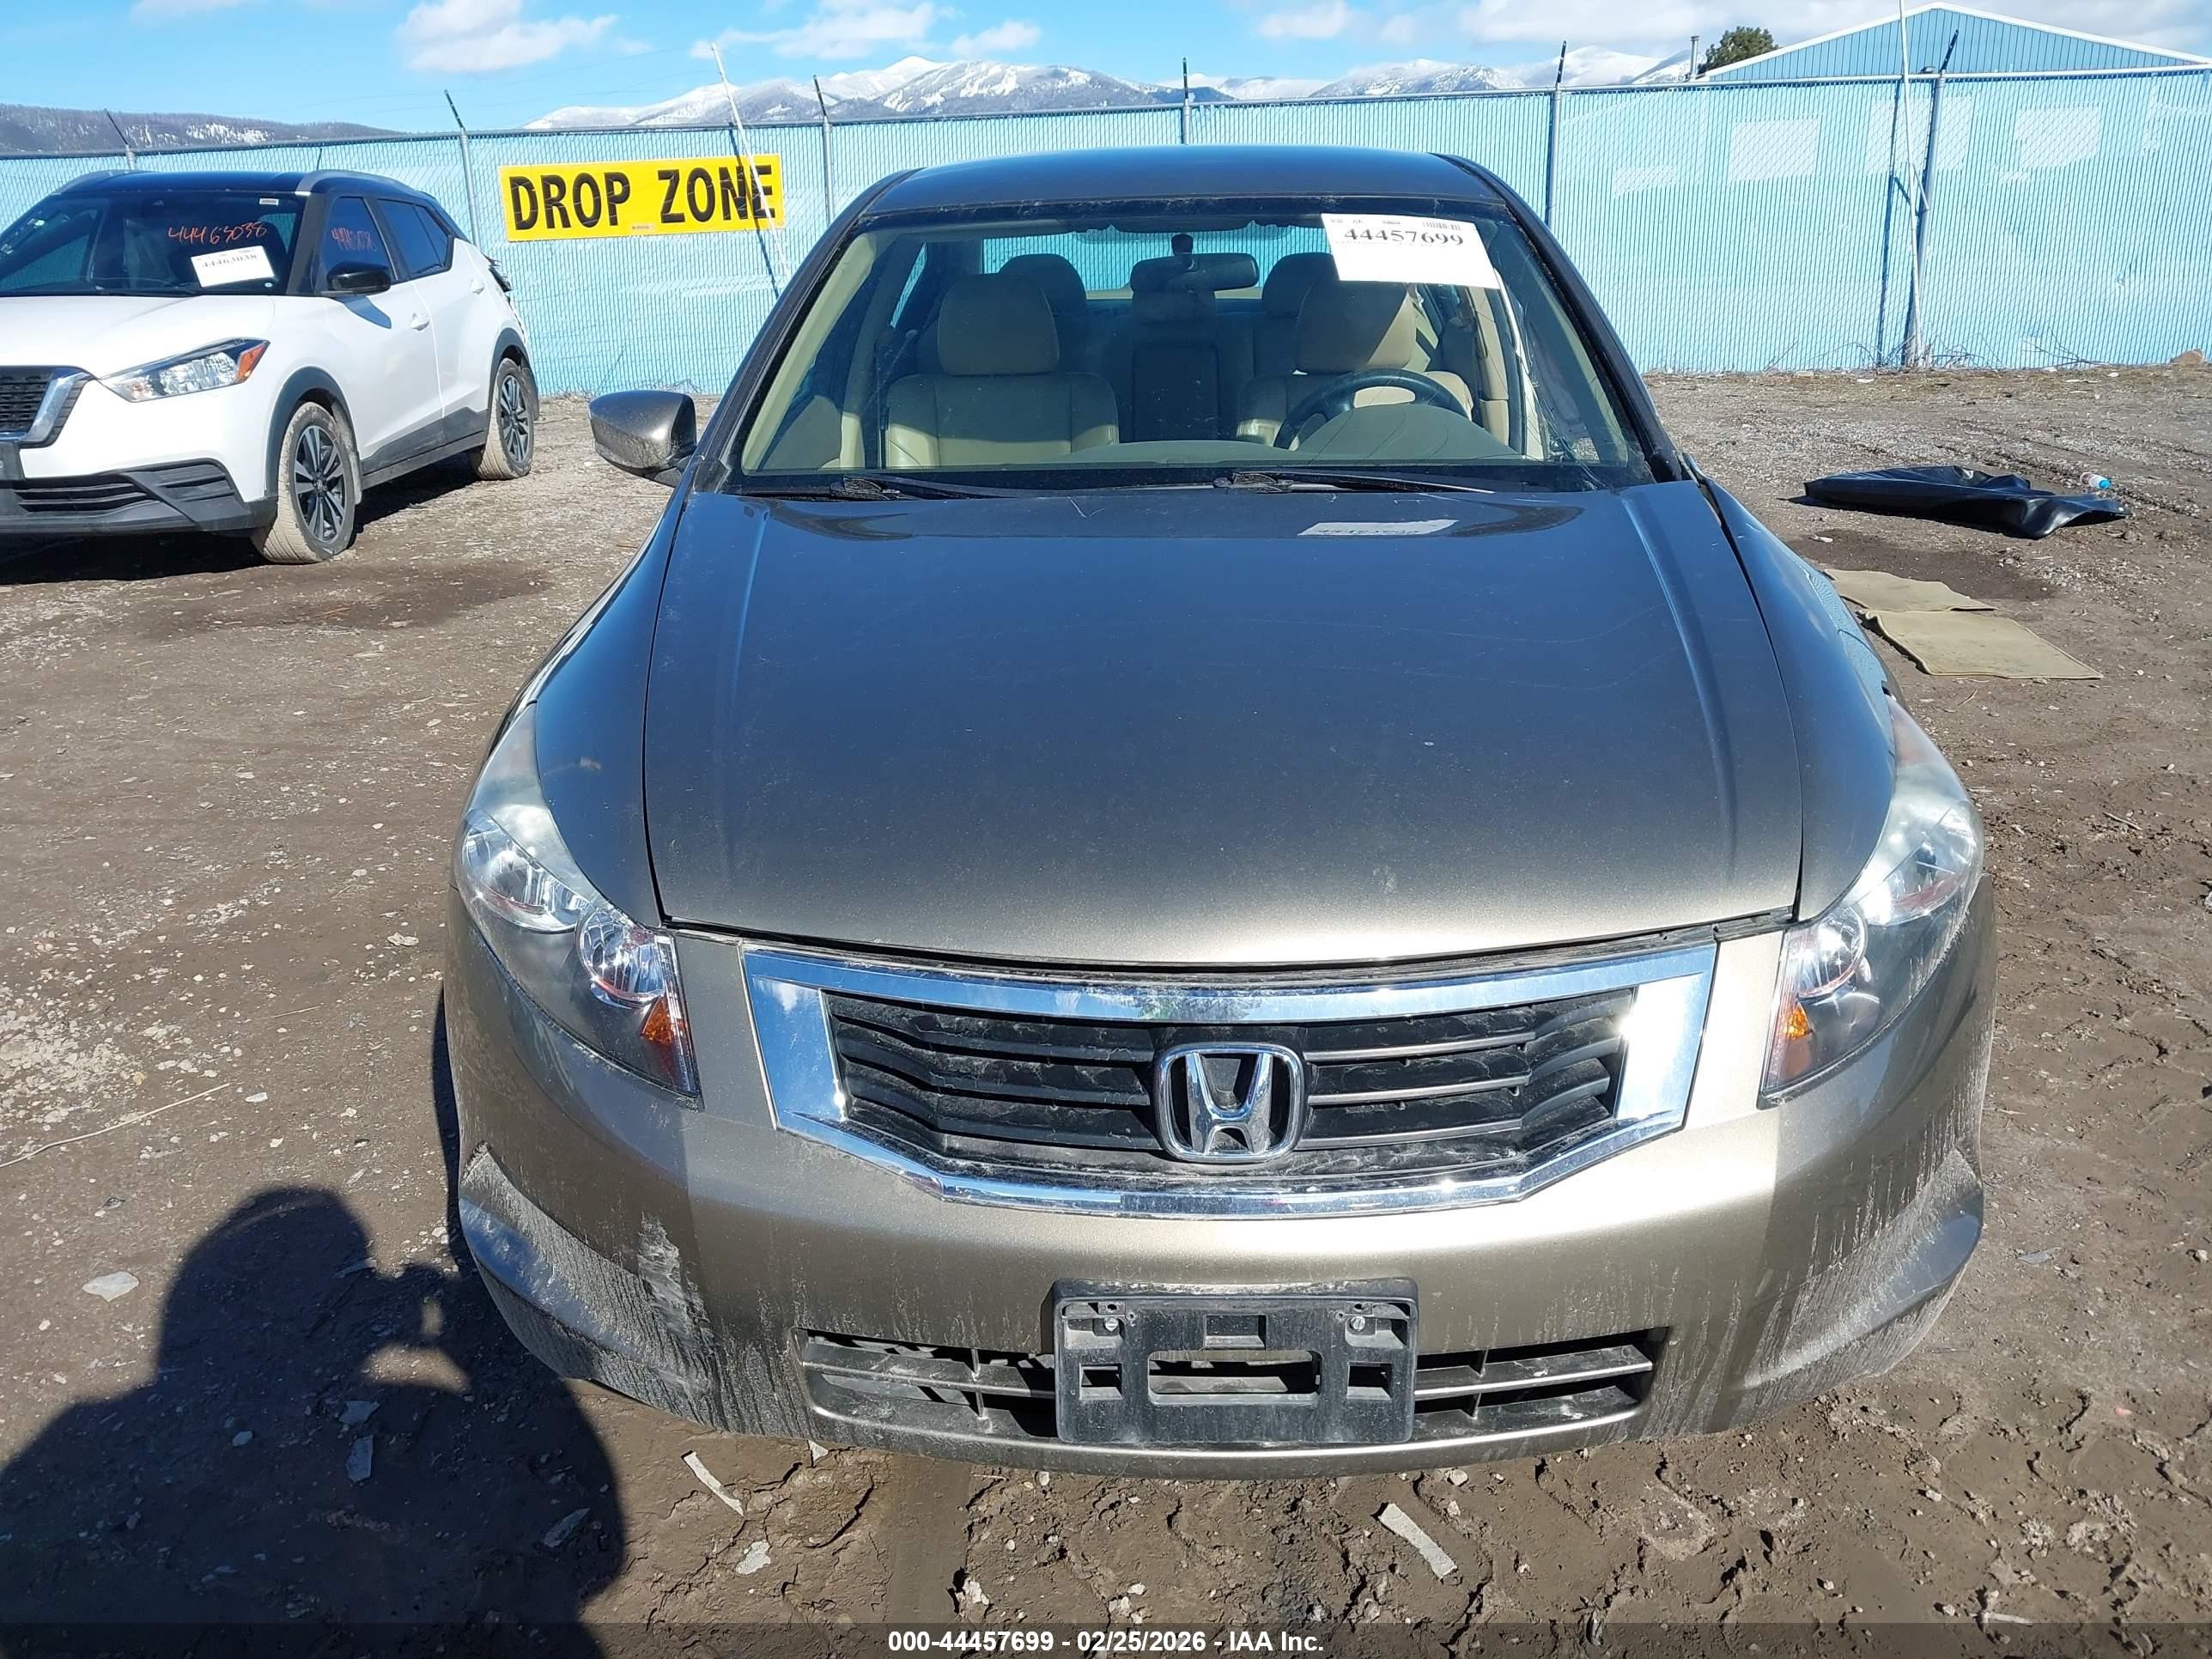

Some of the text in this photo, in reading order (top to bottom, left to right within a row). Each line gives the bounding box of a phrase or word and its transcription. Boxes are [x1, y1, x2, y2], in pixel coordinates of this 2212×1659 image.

[509, 164, 775, 230] DROP ZONE
[1344, 228, 1464, 246] 44457699
